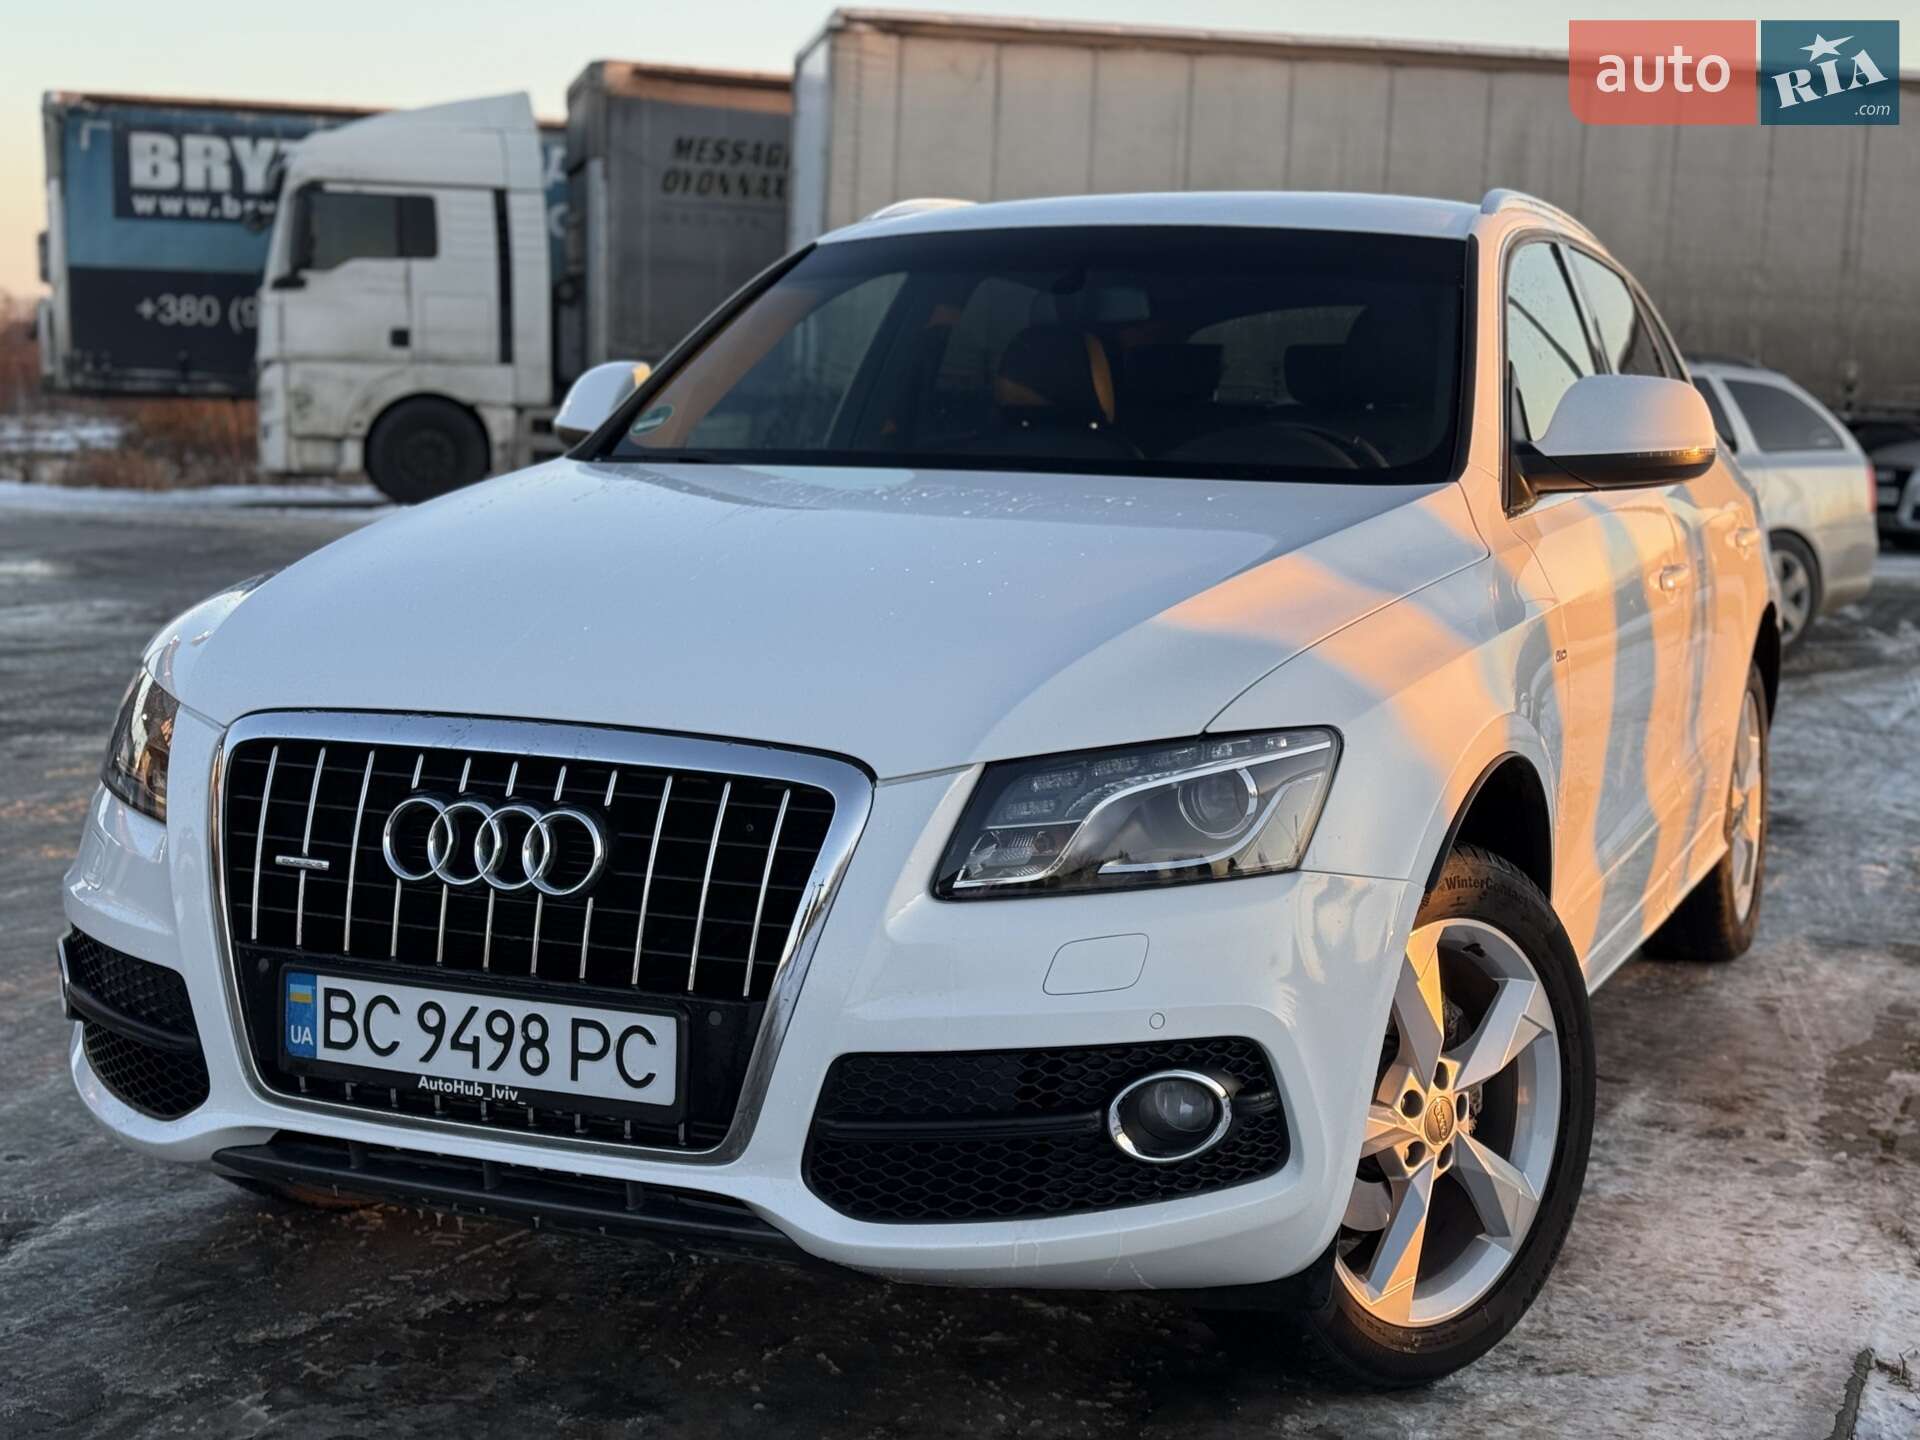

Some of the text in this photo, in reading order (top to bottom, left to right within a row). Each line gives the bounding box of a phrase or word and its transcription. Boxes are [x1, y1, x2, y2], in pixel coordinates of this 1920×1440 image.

[129, 133, 291, 193] BRY
[135, 292, 221, 327] +380
[290, 1026, 314, 1047] UA
[323, 987, 657, 1089] BC 9498 PC
